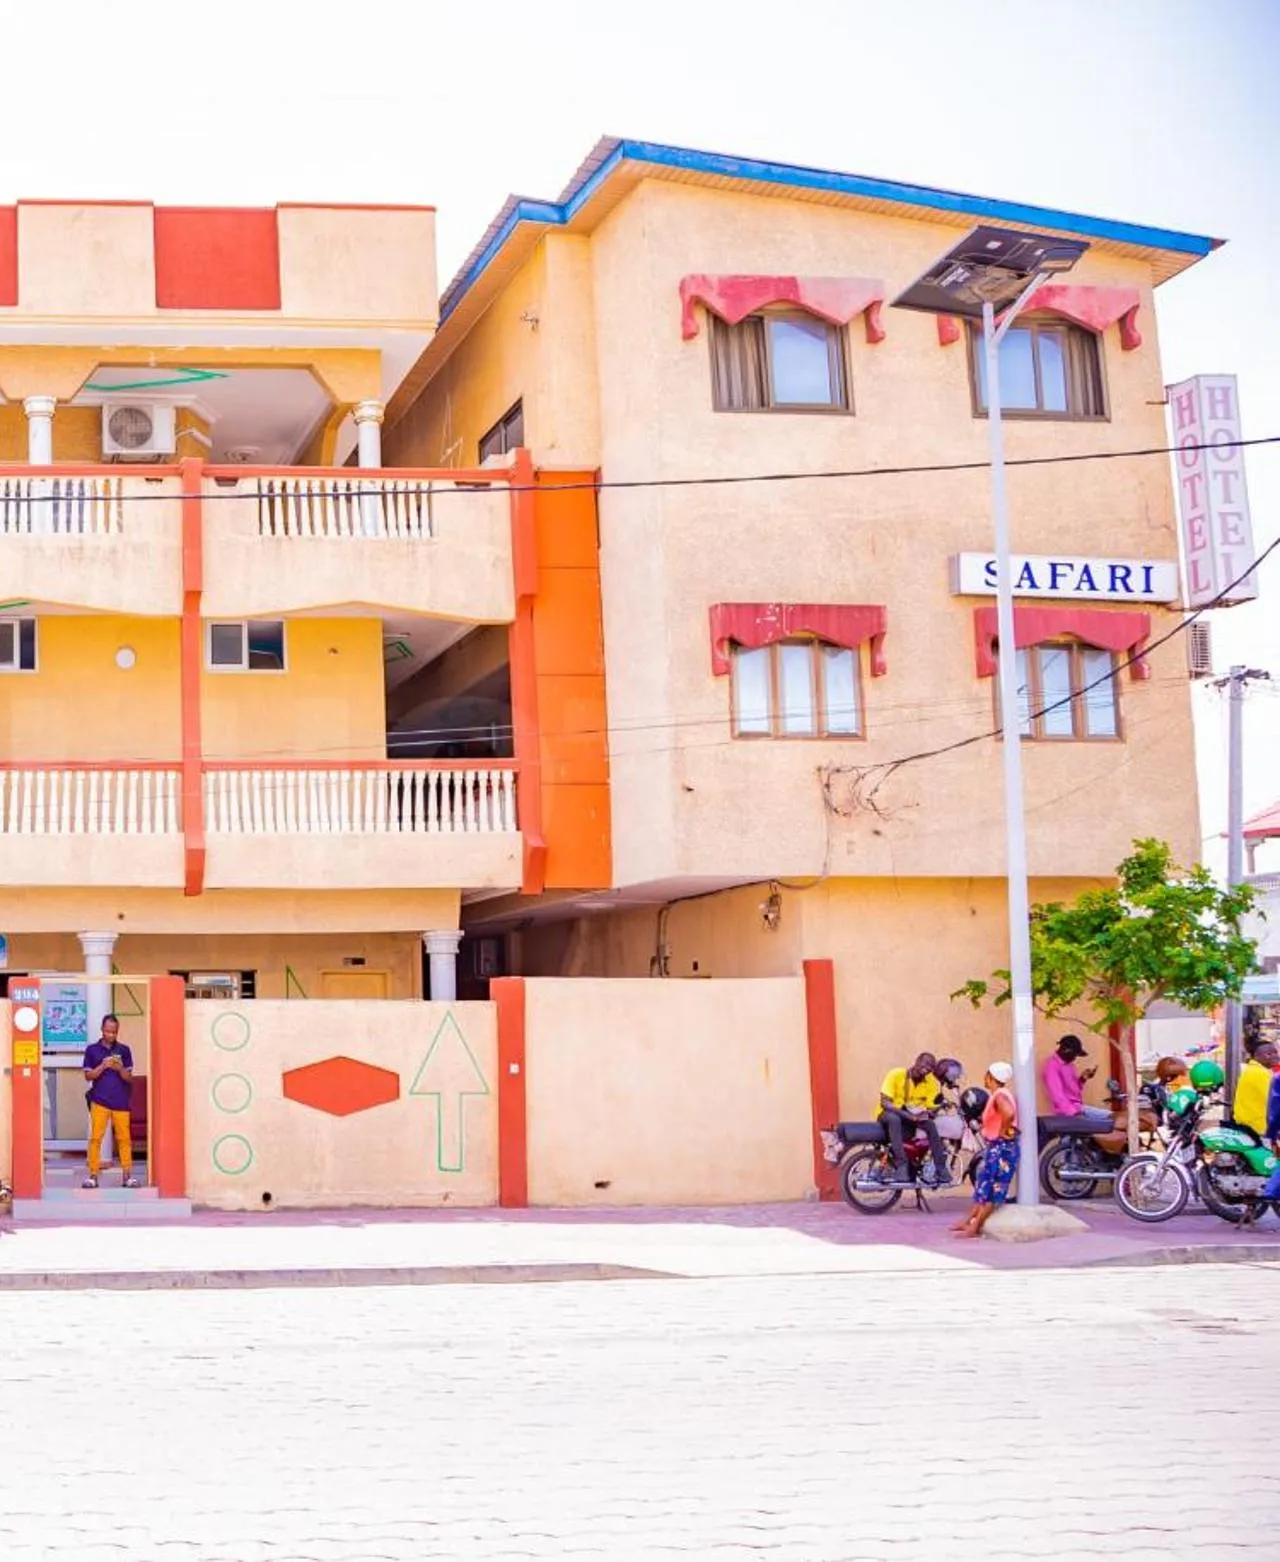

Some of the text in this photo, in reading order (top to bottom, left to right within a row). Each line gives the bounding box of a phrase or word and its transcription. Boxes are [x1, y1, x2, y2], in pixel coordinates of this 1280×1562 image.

[983, 559, 1155, 593] SAFARI
[1176, 388, 1211, 595] HOTEL
[1205, 386, 1251, 588] HOTEL
